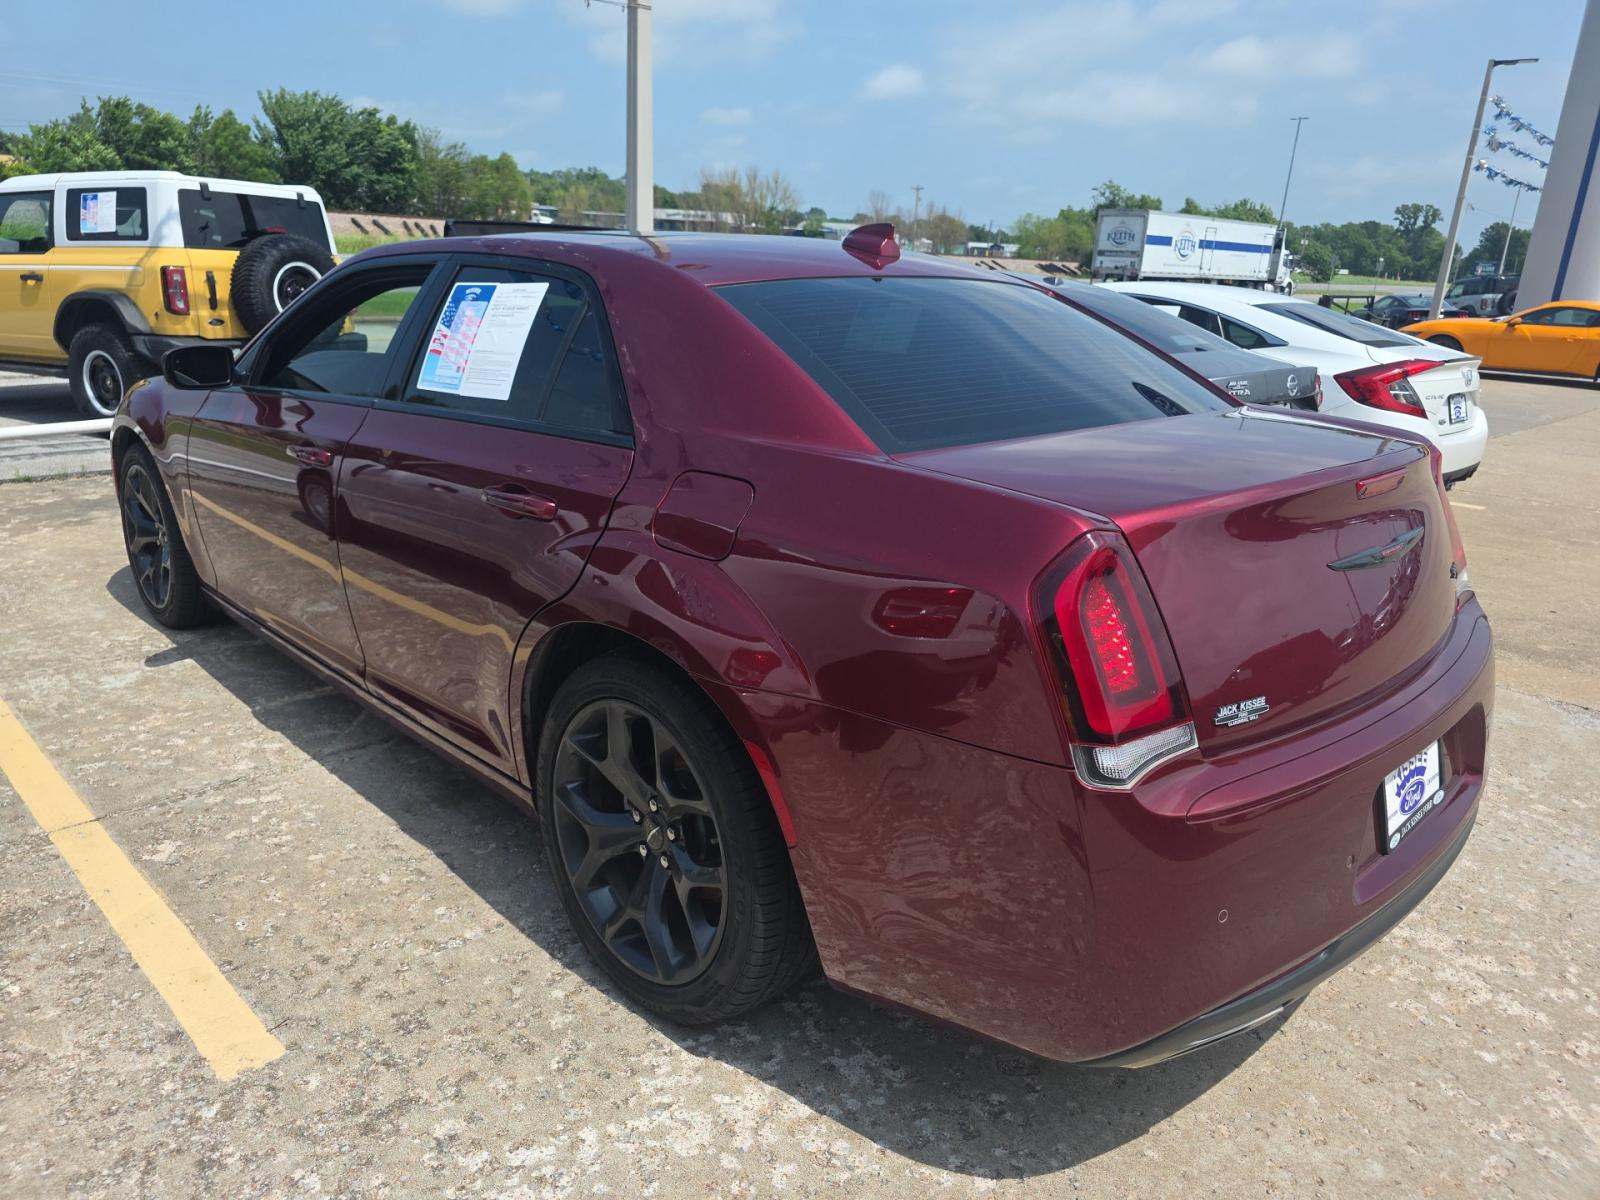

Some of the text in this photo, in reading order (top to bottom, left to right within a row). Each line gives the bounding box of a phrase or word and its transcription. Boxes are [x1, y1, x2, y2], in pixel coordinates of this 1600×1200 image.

[1107, 230, 1136, 243] KEITH
[1174, 238, 1197, 254] KEITH
[1217, 704, 1238, 717] JACK
